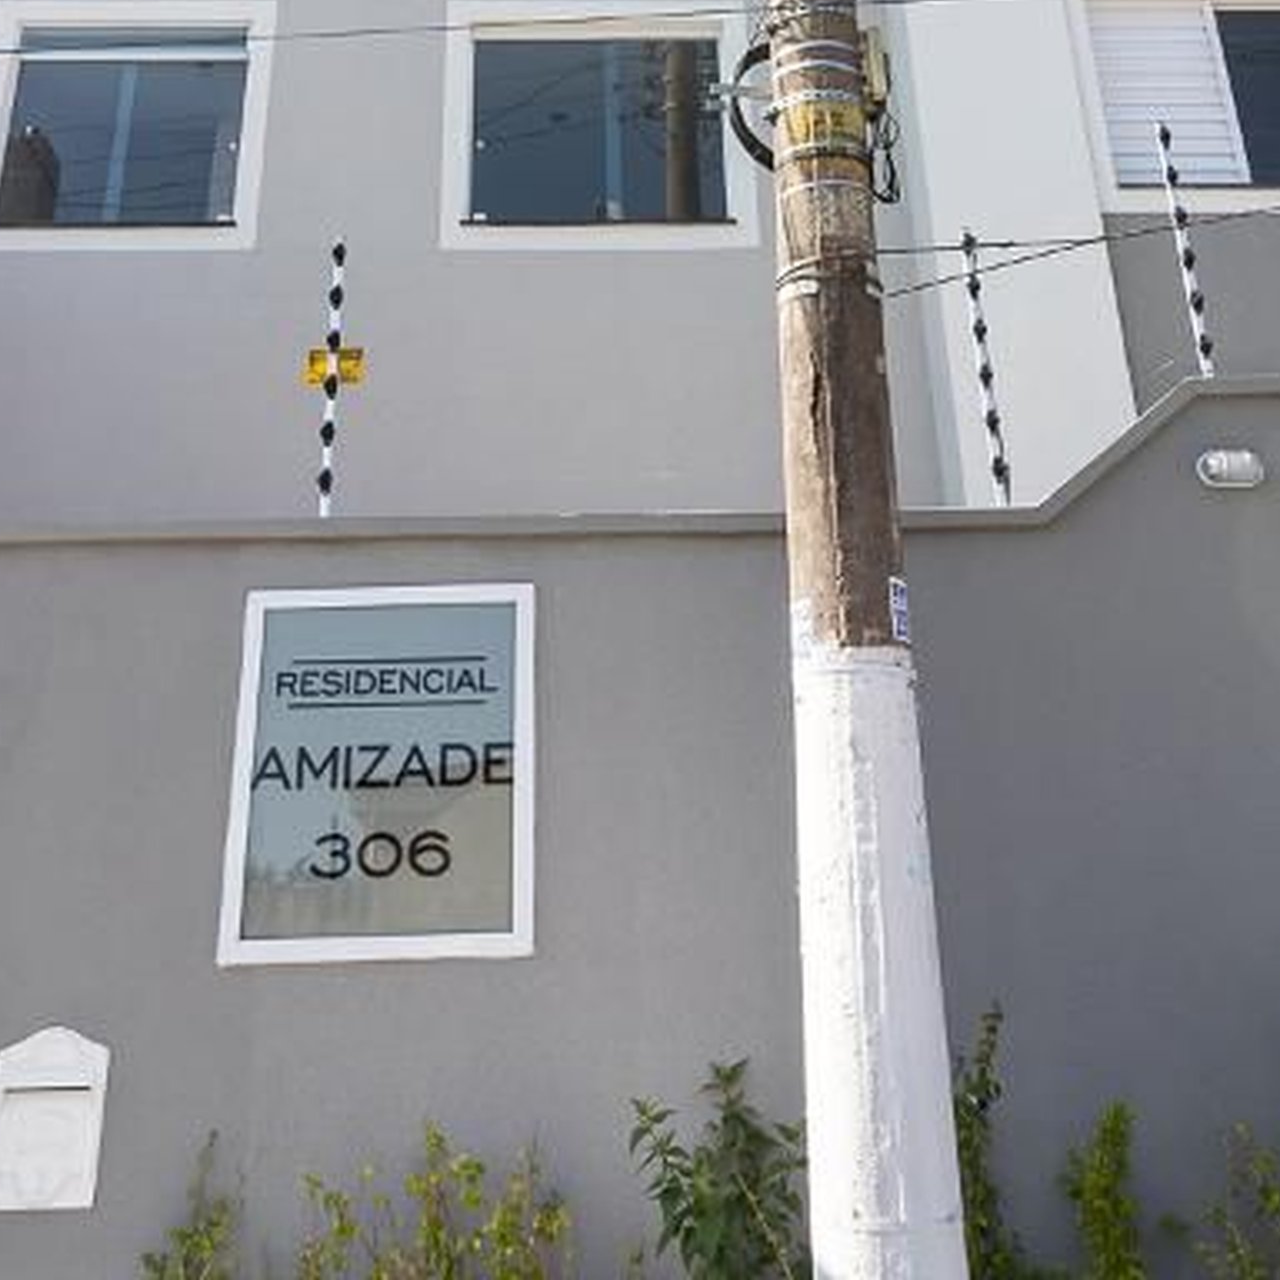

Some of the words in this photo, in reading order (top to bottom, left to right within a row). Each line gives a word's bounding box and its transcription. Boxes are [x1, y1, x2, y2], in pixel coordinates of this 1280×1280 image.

[275, 667, 499, 698] RESIDENCIAL
[250, 741, 515, 791] AMIZADE
[308, 830, 452, 880] 306
